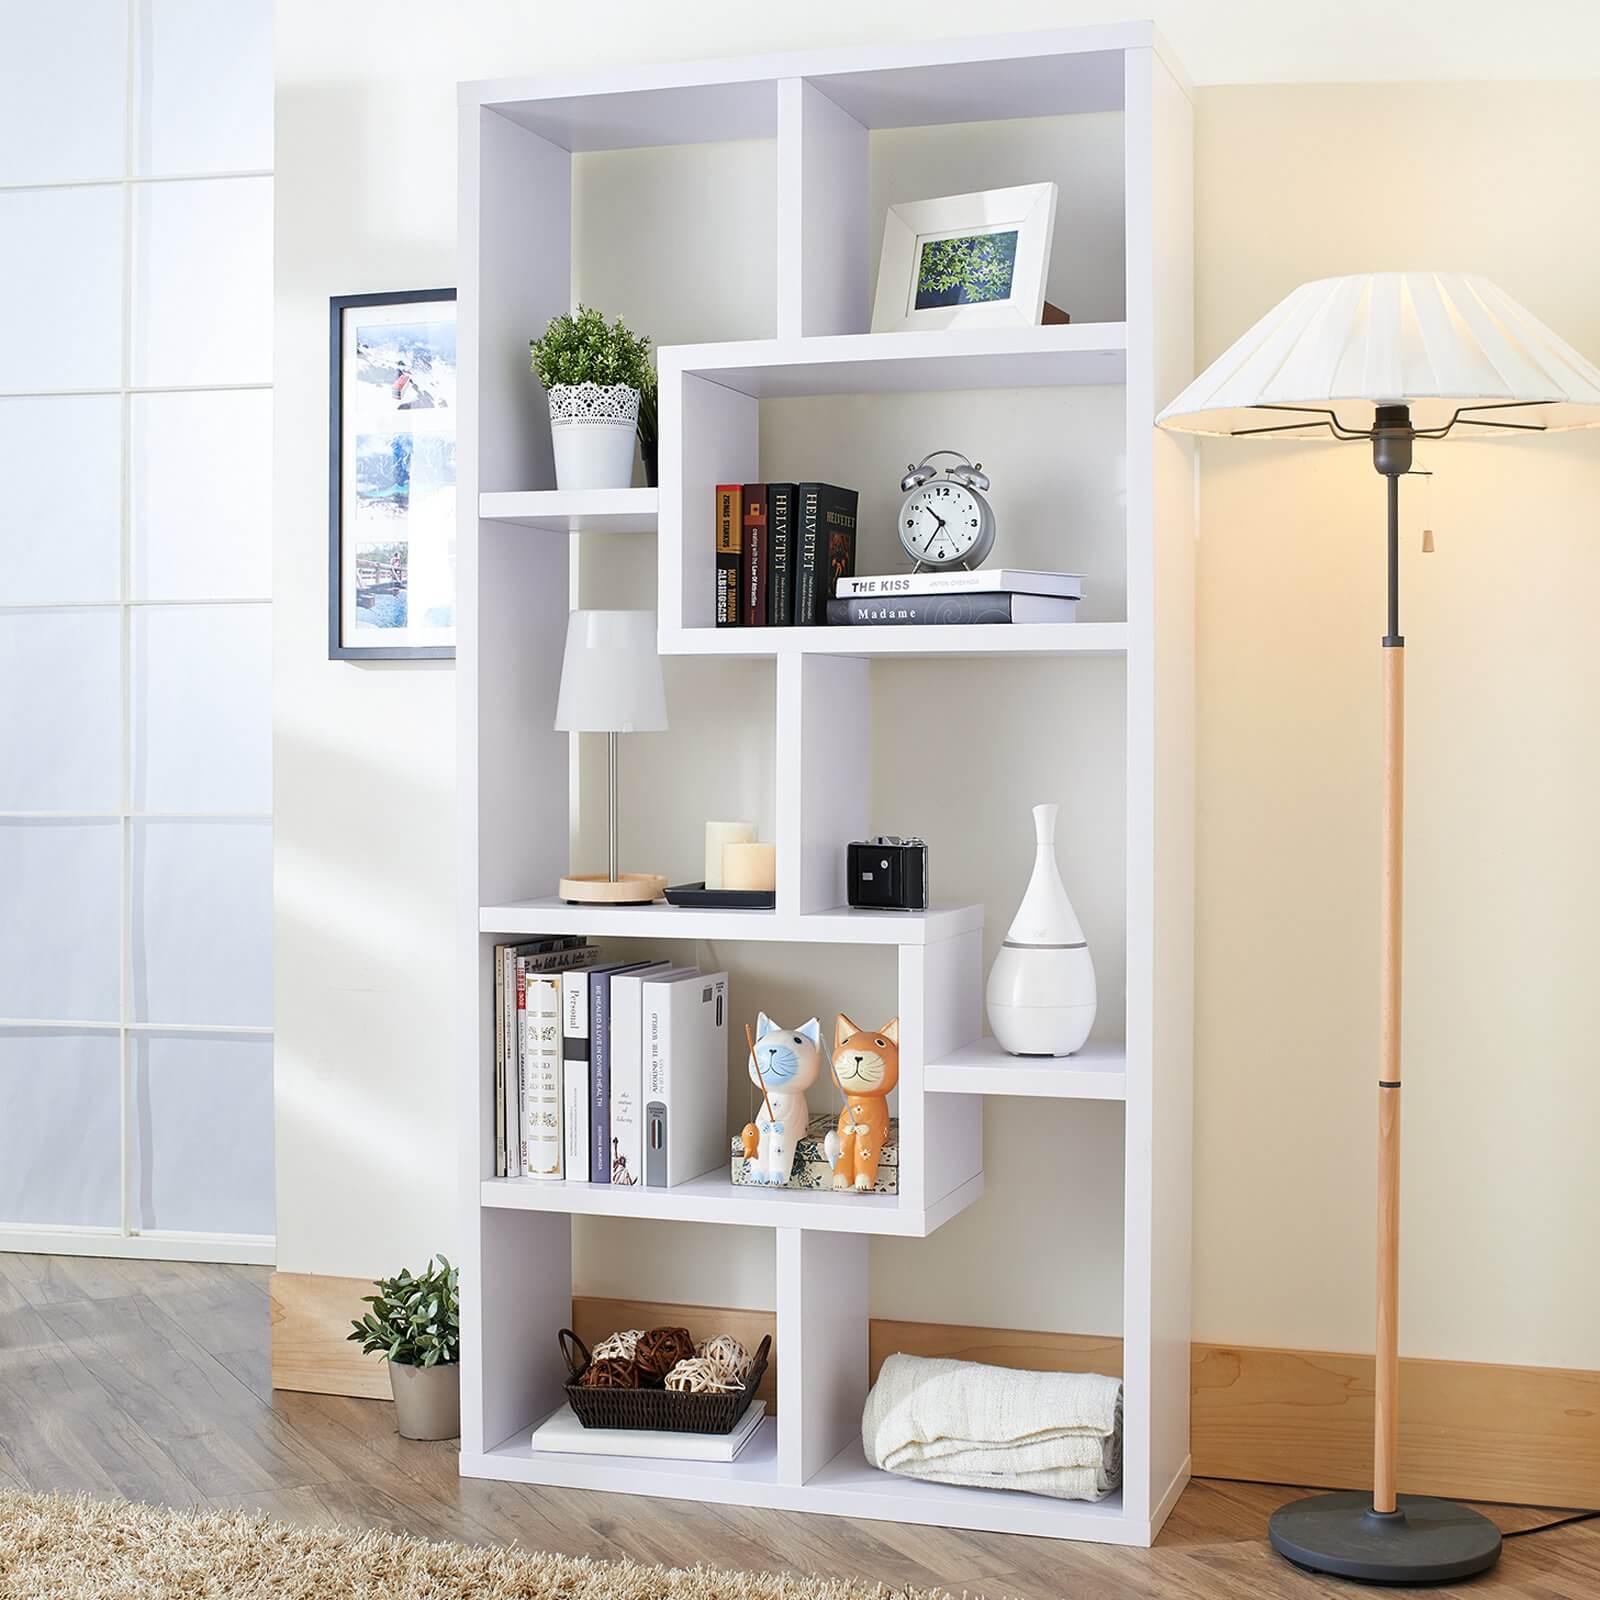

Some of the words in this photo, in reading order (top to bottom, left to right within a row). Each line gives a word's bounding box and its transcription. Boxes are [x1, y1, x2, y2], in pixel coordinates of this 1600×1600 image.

[936, 488, 950, 496] 12
[907, 519, 914, 528] 9
[971, 519, 978, 527] 3
[775, 495, 787, 572] HELVETET
[803, 493, 818, 571] HELVETET
[938, 550, 945, 559] 6
[851, 582, 876, 593] THE
[880, 579, 910, 591] KISS
[858, 608, 917, 619] Madame
[595, 985, 602, 995] BE
[570, 990, 580, 1029] Personal
[596, 1045, 602, 1054] IN
